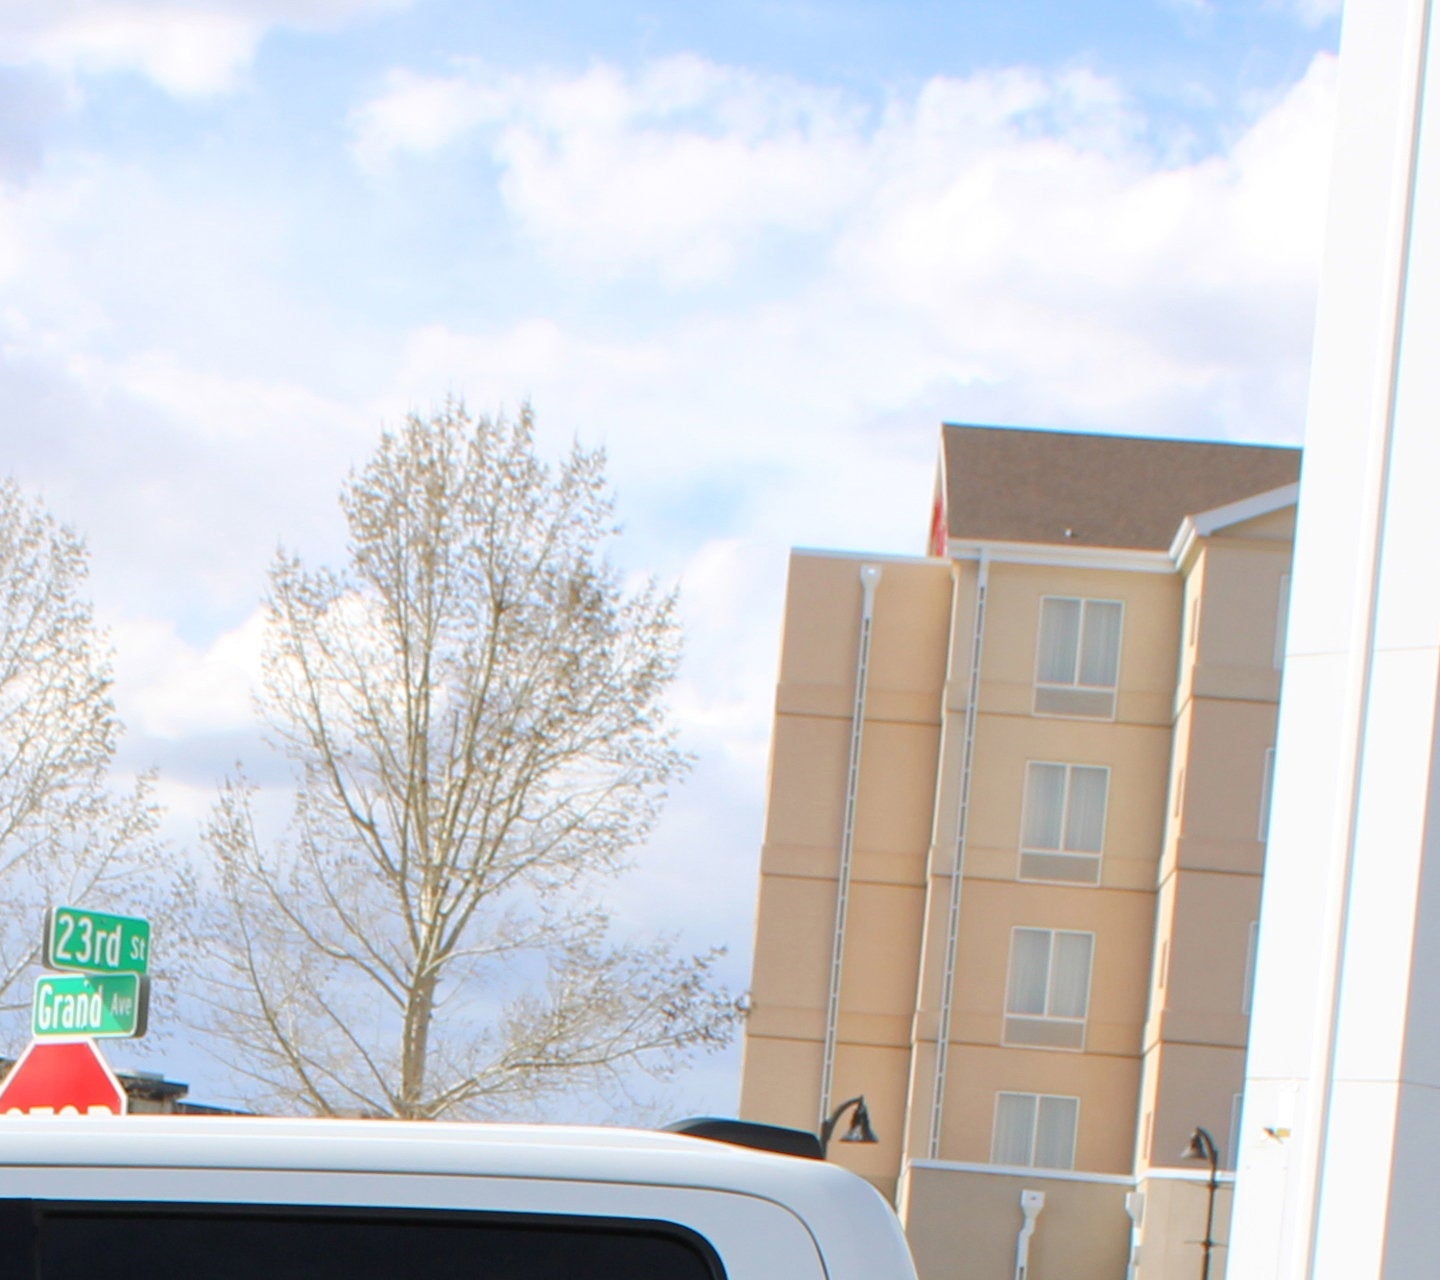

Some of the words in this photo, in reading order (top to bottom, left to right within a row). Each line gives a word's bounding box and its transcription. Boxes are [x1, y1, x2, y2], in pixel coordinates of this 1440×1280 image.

[56, 914, 122, 967] 23rd
[130, 937, 145, 961] St
[38, 984, 103, 1031] Grand
[110, 993, 132, 1016] Ave
